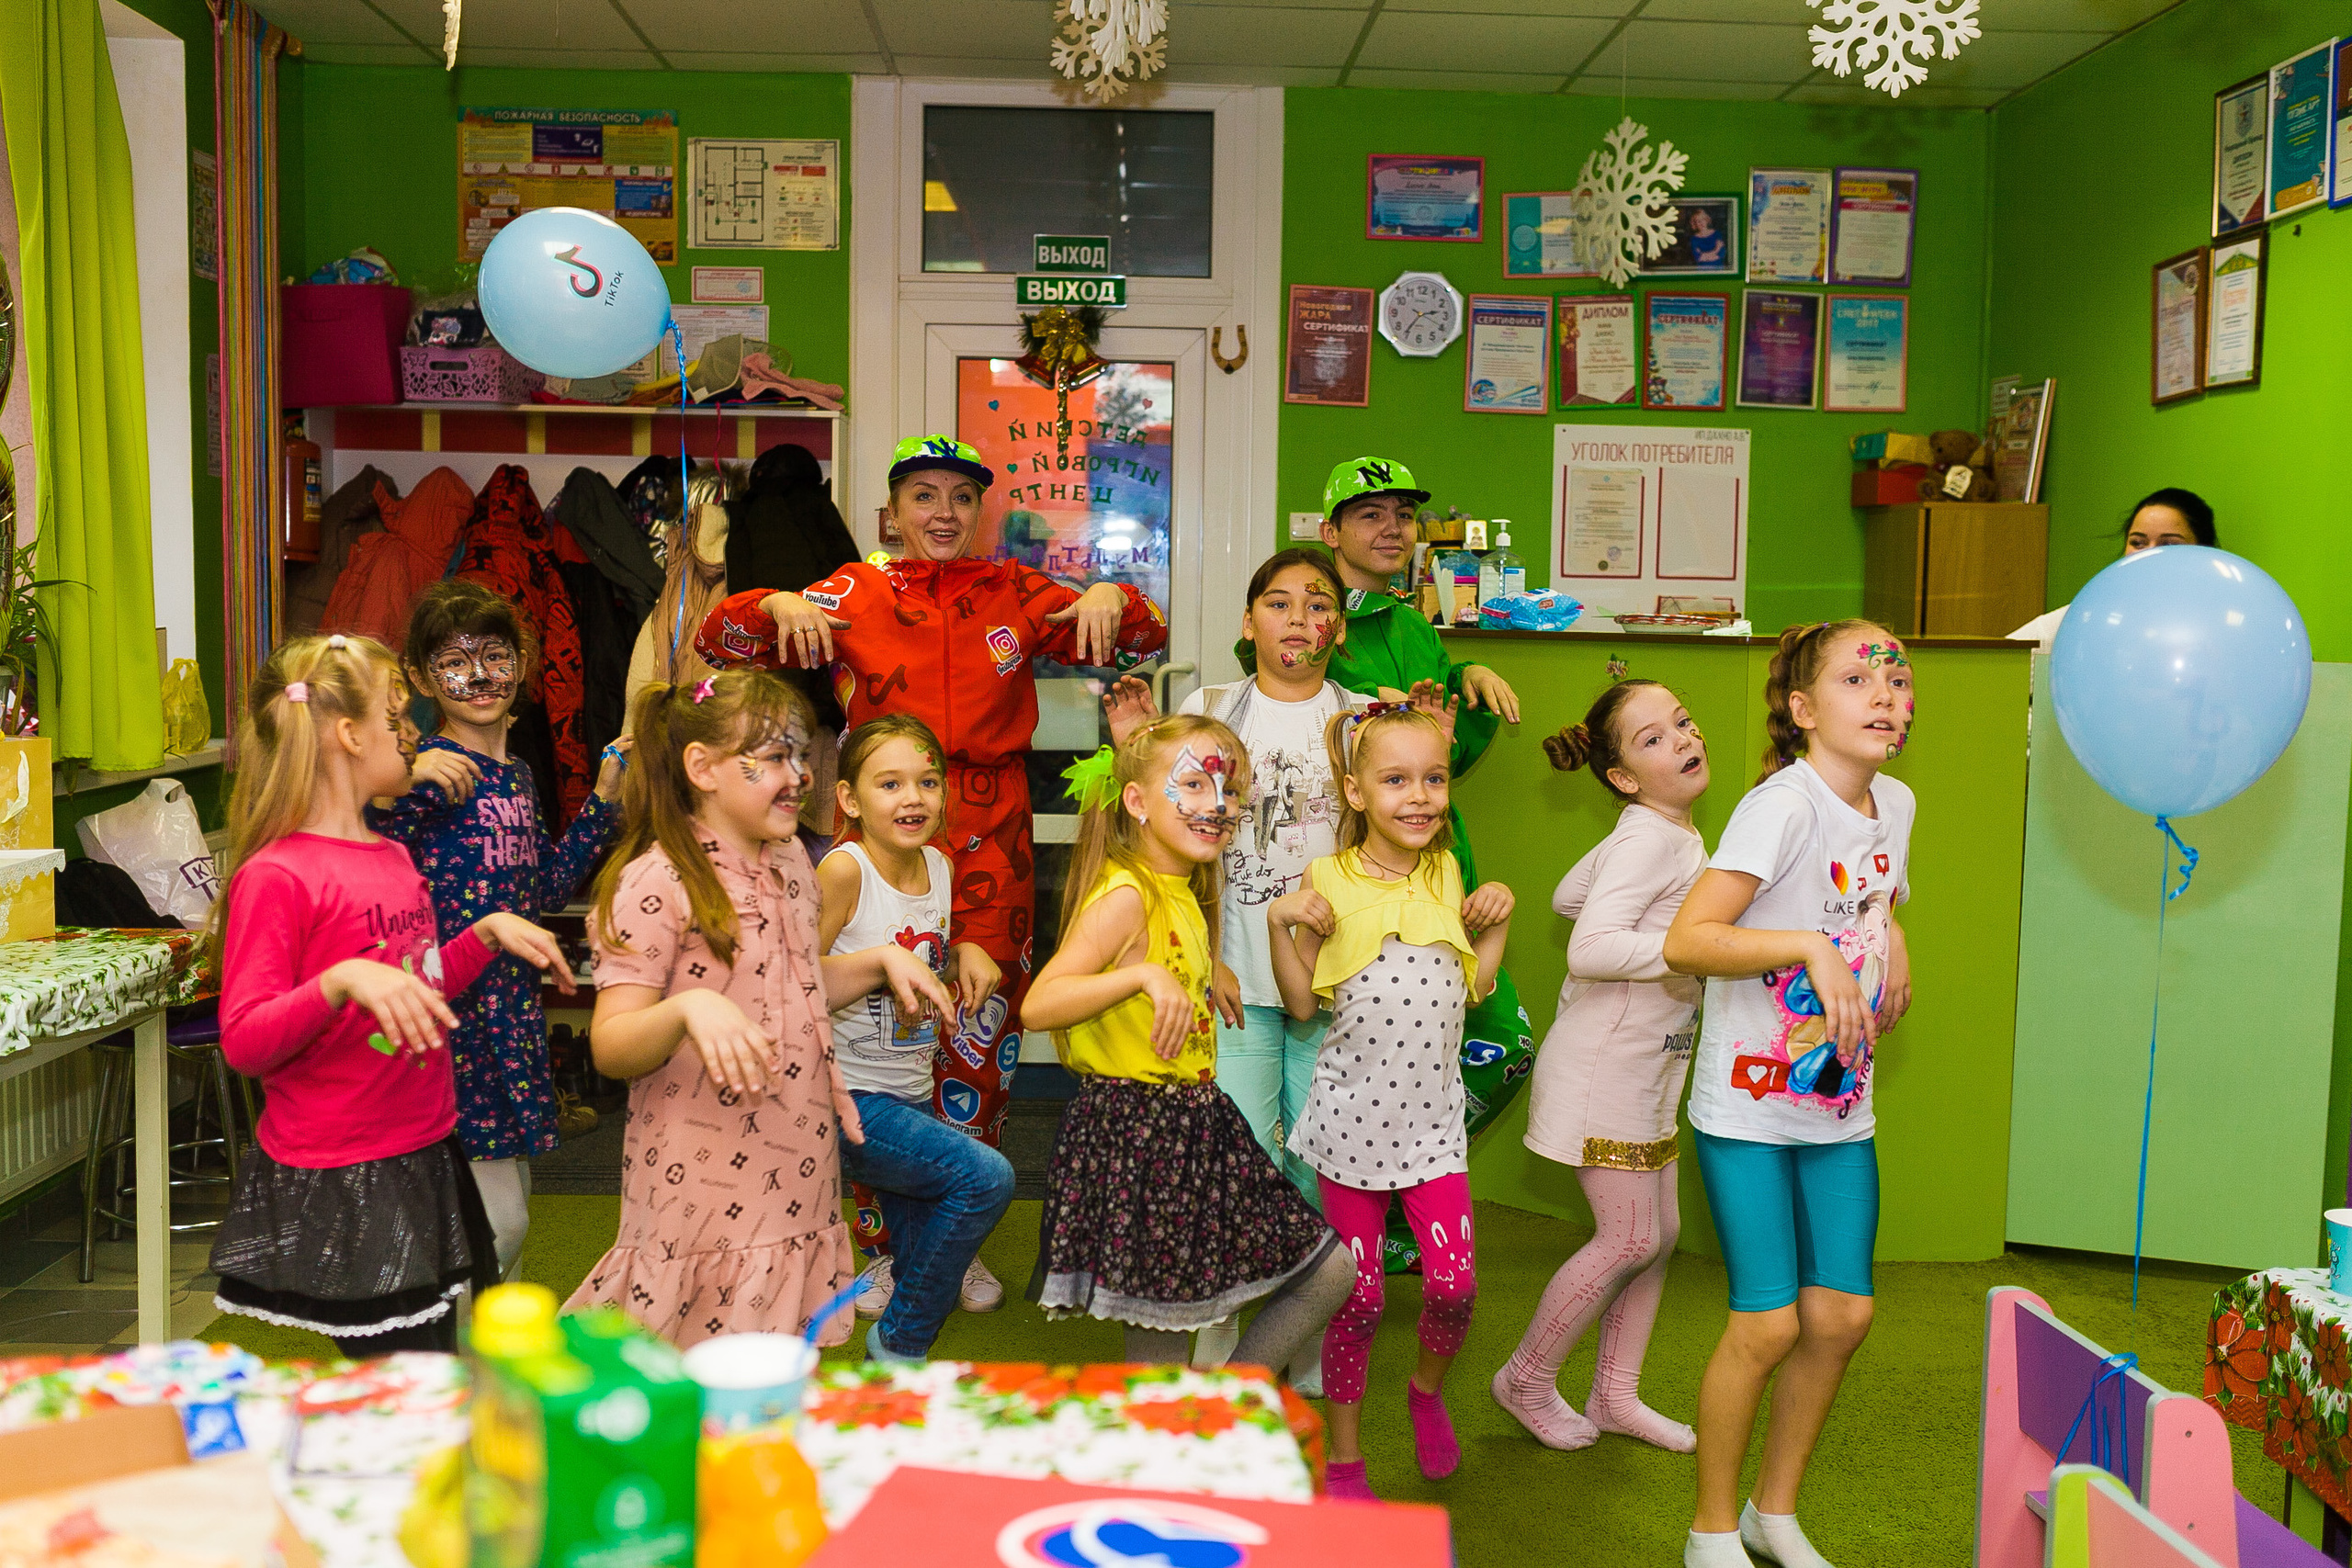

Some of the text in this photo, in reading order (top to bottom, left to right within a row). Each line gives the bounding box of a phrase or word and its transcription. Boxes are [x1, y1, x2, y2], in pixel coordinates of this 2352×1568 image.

[494, 110, 641, 123] ПОЖАРНАЯ БЕЗОПАСНОСТЬ
[1038, 245, 1105, 268] ВЫХОД
[604, 270, 625, 307] TikTok
[1027, 280, 1116, 303] ВЫХОД
[1417, 286, 1428, 295] 12
[1438, 299, 1445, 309] 2
[1299, 310, 1331, 320] ЖАРА
[1391, 309, 1397, 318] 9
[1442, 310, 1449, 322] 3
[1476, 315, 1543, 326] СЕРТИФИКАТ
[1581, 306, 1629, 321] ДИПЛОМ
[1657, 310, 1719, 325] СЕРТИФИКАТ
[1303, 321, 1368, 333] СЕРТИФИКАТ
[1438, 323, 1445, 332] 4
[1415, 333, 1423, 344] 6
[1429, 330, 1437, 343] 5
[1571, 442, 1735, 466] УГОЛОК ПОТРЕБИТЕЛЯ
[1355, 460, 1394, 489] NY
[805, 592, 838, 608] YouTube
[1351, 589, 1367, 610] Whats
[1824, 899, 1855, 915] LIKE
[1662, 1032, 1694, 1053] PAWS
[951, 1035, 985, 1067] viber
